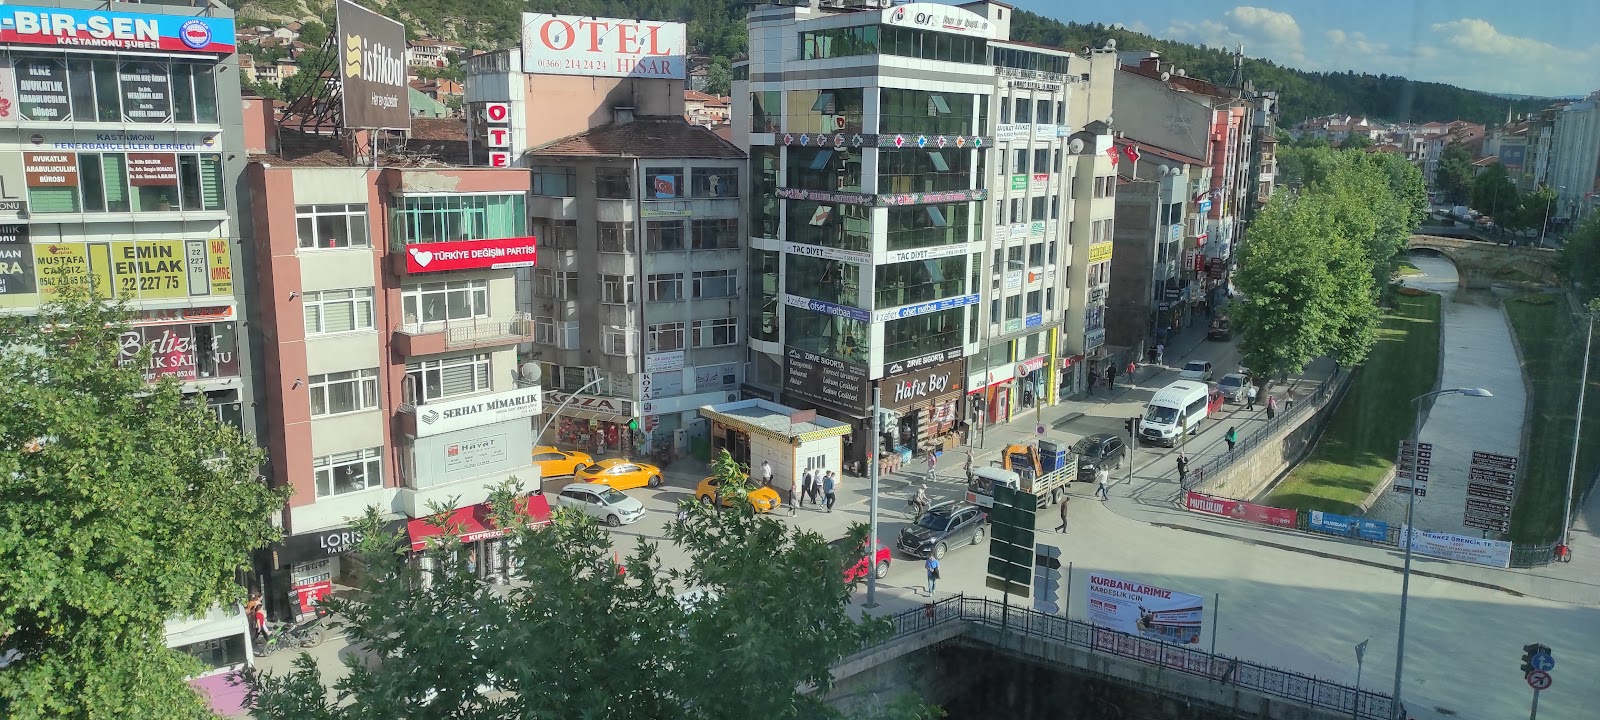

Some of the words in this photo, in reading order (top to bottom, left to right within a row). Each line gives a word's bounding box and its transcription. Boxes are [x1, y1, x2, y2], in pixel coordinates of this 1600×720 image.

[57, 37, 122, 48] KASTAMONU
[124, 39, 160, 49] ŞUBESİ
[539, 19, 671, 57] OTEL
[363, 37, 404, 87] istikbal
[537, 58, 562, 69] 0(366)
[564, 59, 580, 70] 214
[583, 60, 593, 70] 24
[596, 60, 607, 70] 24
[616, 56, 672, 75] HİSAR
[21, 80, 63, 91] AVUKATLIK
[55, 142, 150, 150] FENERBAHÇELİLER
[33, 155, 68, 163] AVUKATLIK
[40, 175, 65, 183] BÜROSU
[124, 245, 172, 259] EMİN
[211, 241, 226, 254] HAC
[433, 250, 469, 261] TÜRKİYE
[472, 247, 505, 258] DEĞİŞİM
[506, 245, 535, 256] PARTİSİ
[37, 256, 84, 265] MUSTAFA
[217, 256, 222, 264] VE
[115, 260, 183, 275] EMLAK
[211, 267, 230, 280] UMRE
[122, 278, 136, 291] 22
[141, 276, 161, 290] 227
[165, 276, 179, 289] 75
[810, 302, 826, 313] ofset
[642, 374, 651, 399] KOZA
[895, 379, 927, 403] Hafız
[928, 374, 950, 392] Bey
[443, 403, 484, 419] SERHAT
[486, 394, 537, 411] MİMARLIK
[545, 393, 615, 409] KOZA
[1189, 498, 1224, 513] MUTLULUK
[1422, 533, 1449, 541] MERKEZ
[1090, 575, 1171, 600] KURBANLARIMIZ
